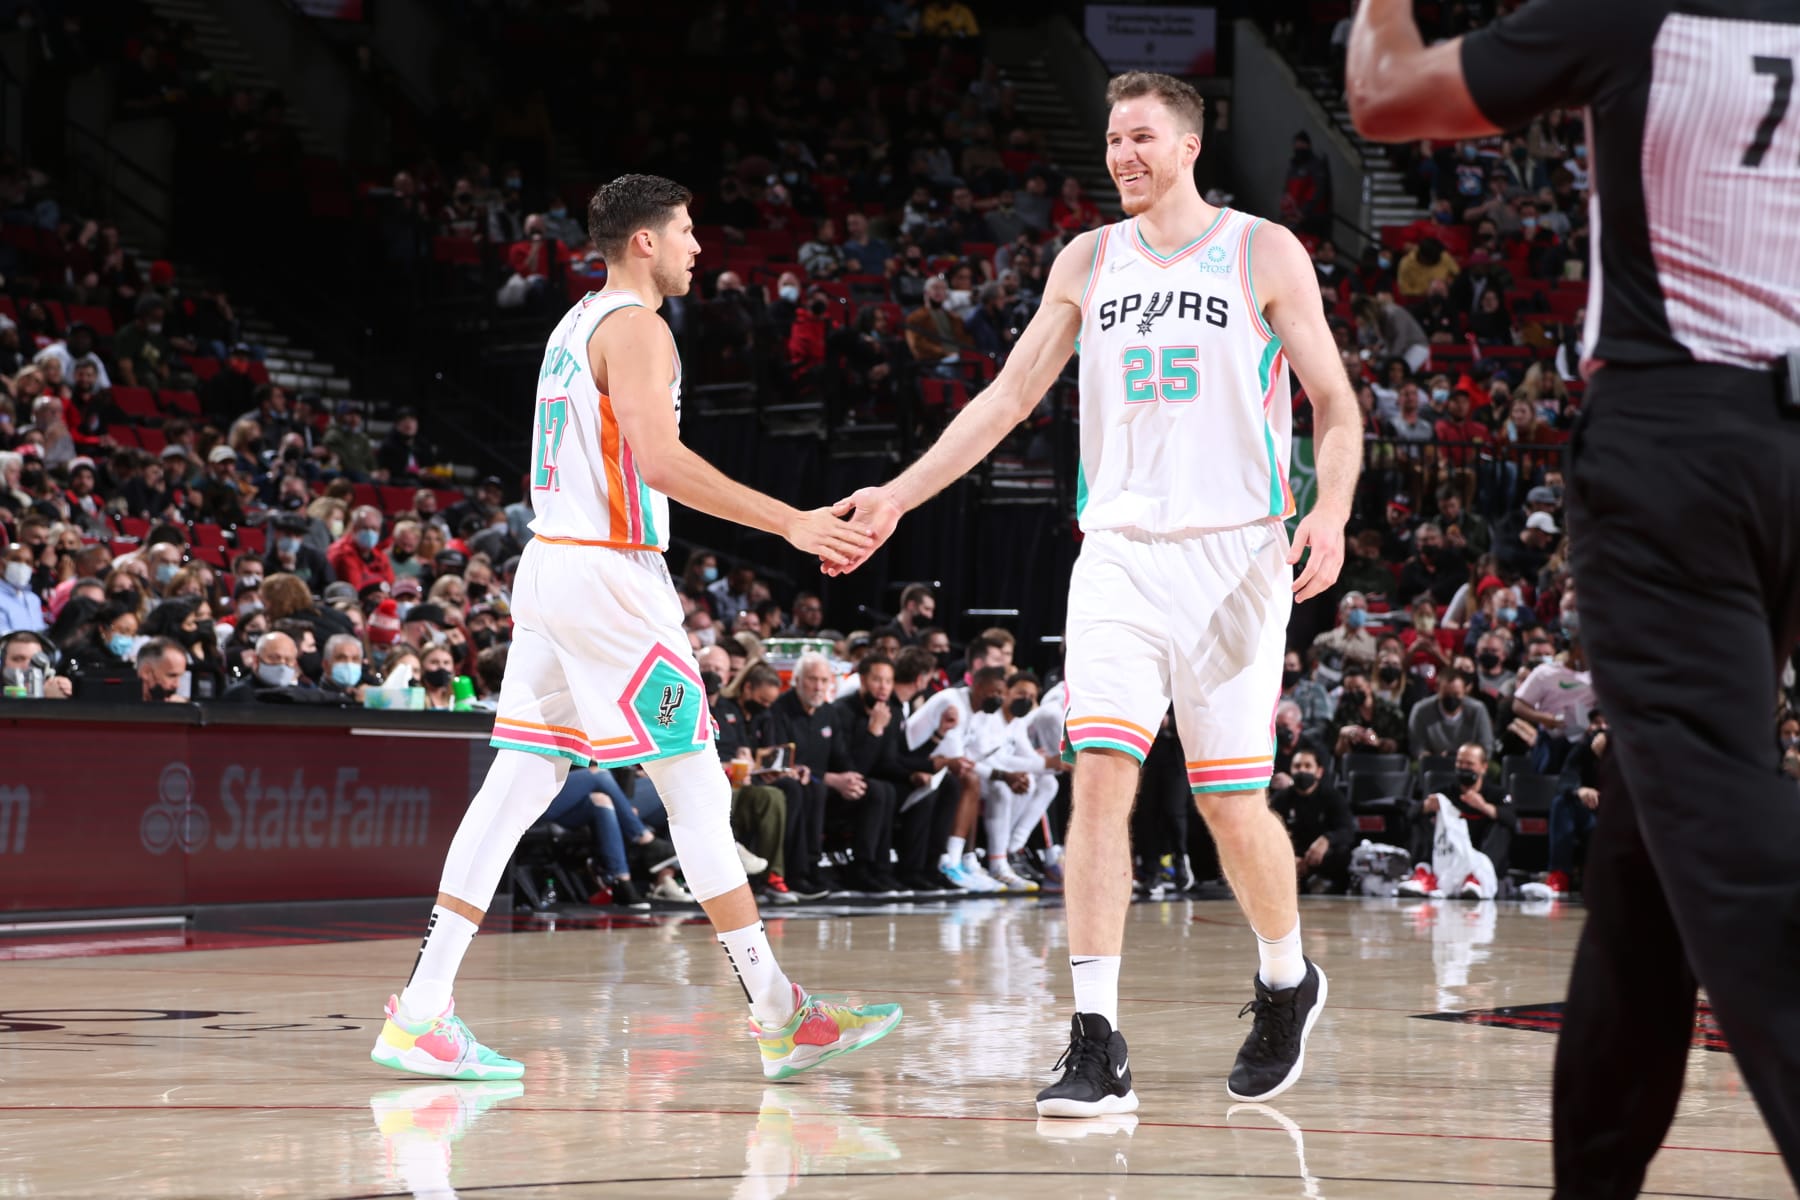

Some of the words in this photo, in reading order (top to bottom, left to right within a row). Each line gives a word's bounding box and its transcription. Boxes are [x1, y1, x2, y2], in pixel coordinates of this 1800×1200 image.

[1741, 55, 1800, 168] 7
[1199, 261, 1232, 274] Frost
[1100, 291, 1229, 336] SPURS
[1122, 345, 1200, 404] 25
